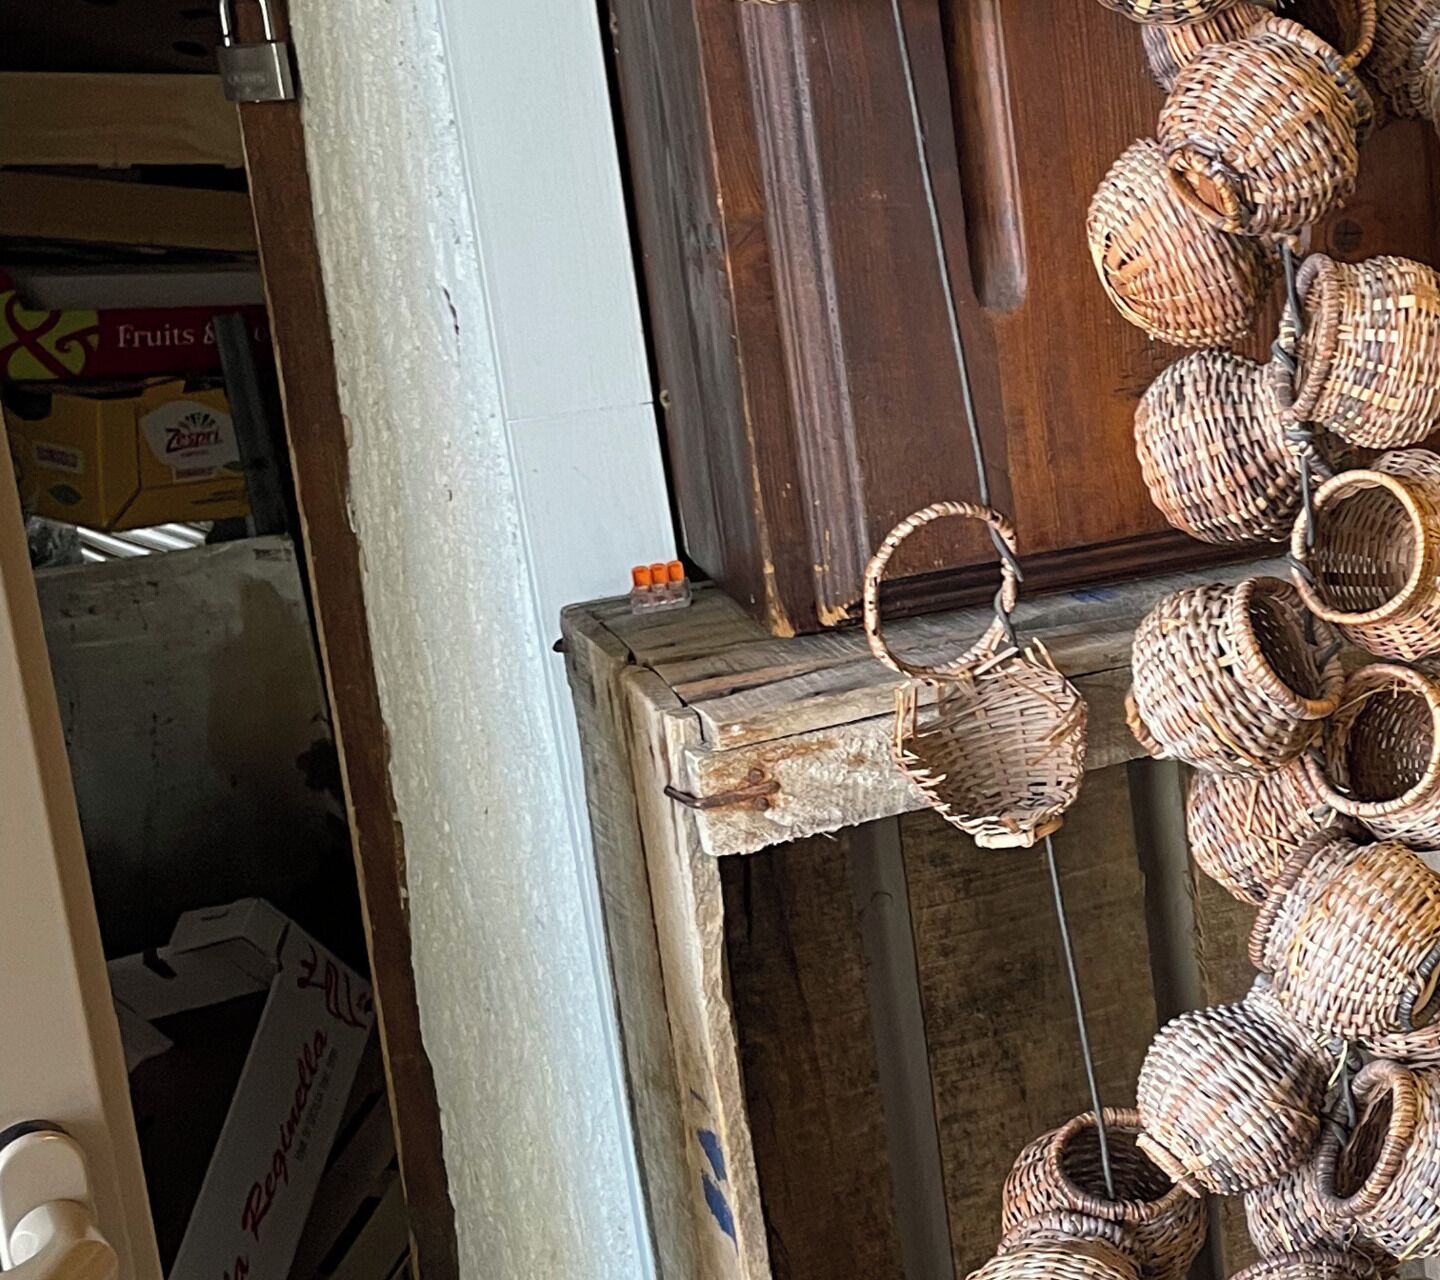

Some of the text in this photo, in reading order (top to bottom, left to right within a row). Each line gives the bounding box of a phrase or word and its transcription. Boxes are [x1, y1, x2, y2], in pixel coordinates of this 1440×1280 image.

[117, 323, 195, 348] Fruits
[165, 428, 223, 454] Zespri
[241, 1029, 330, 1243] Reginella
